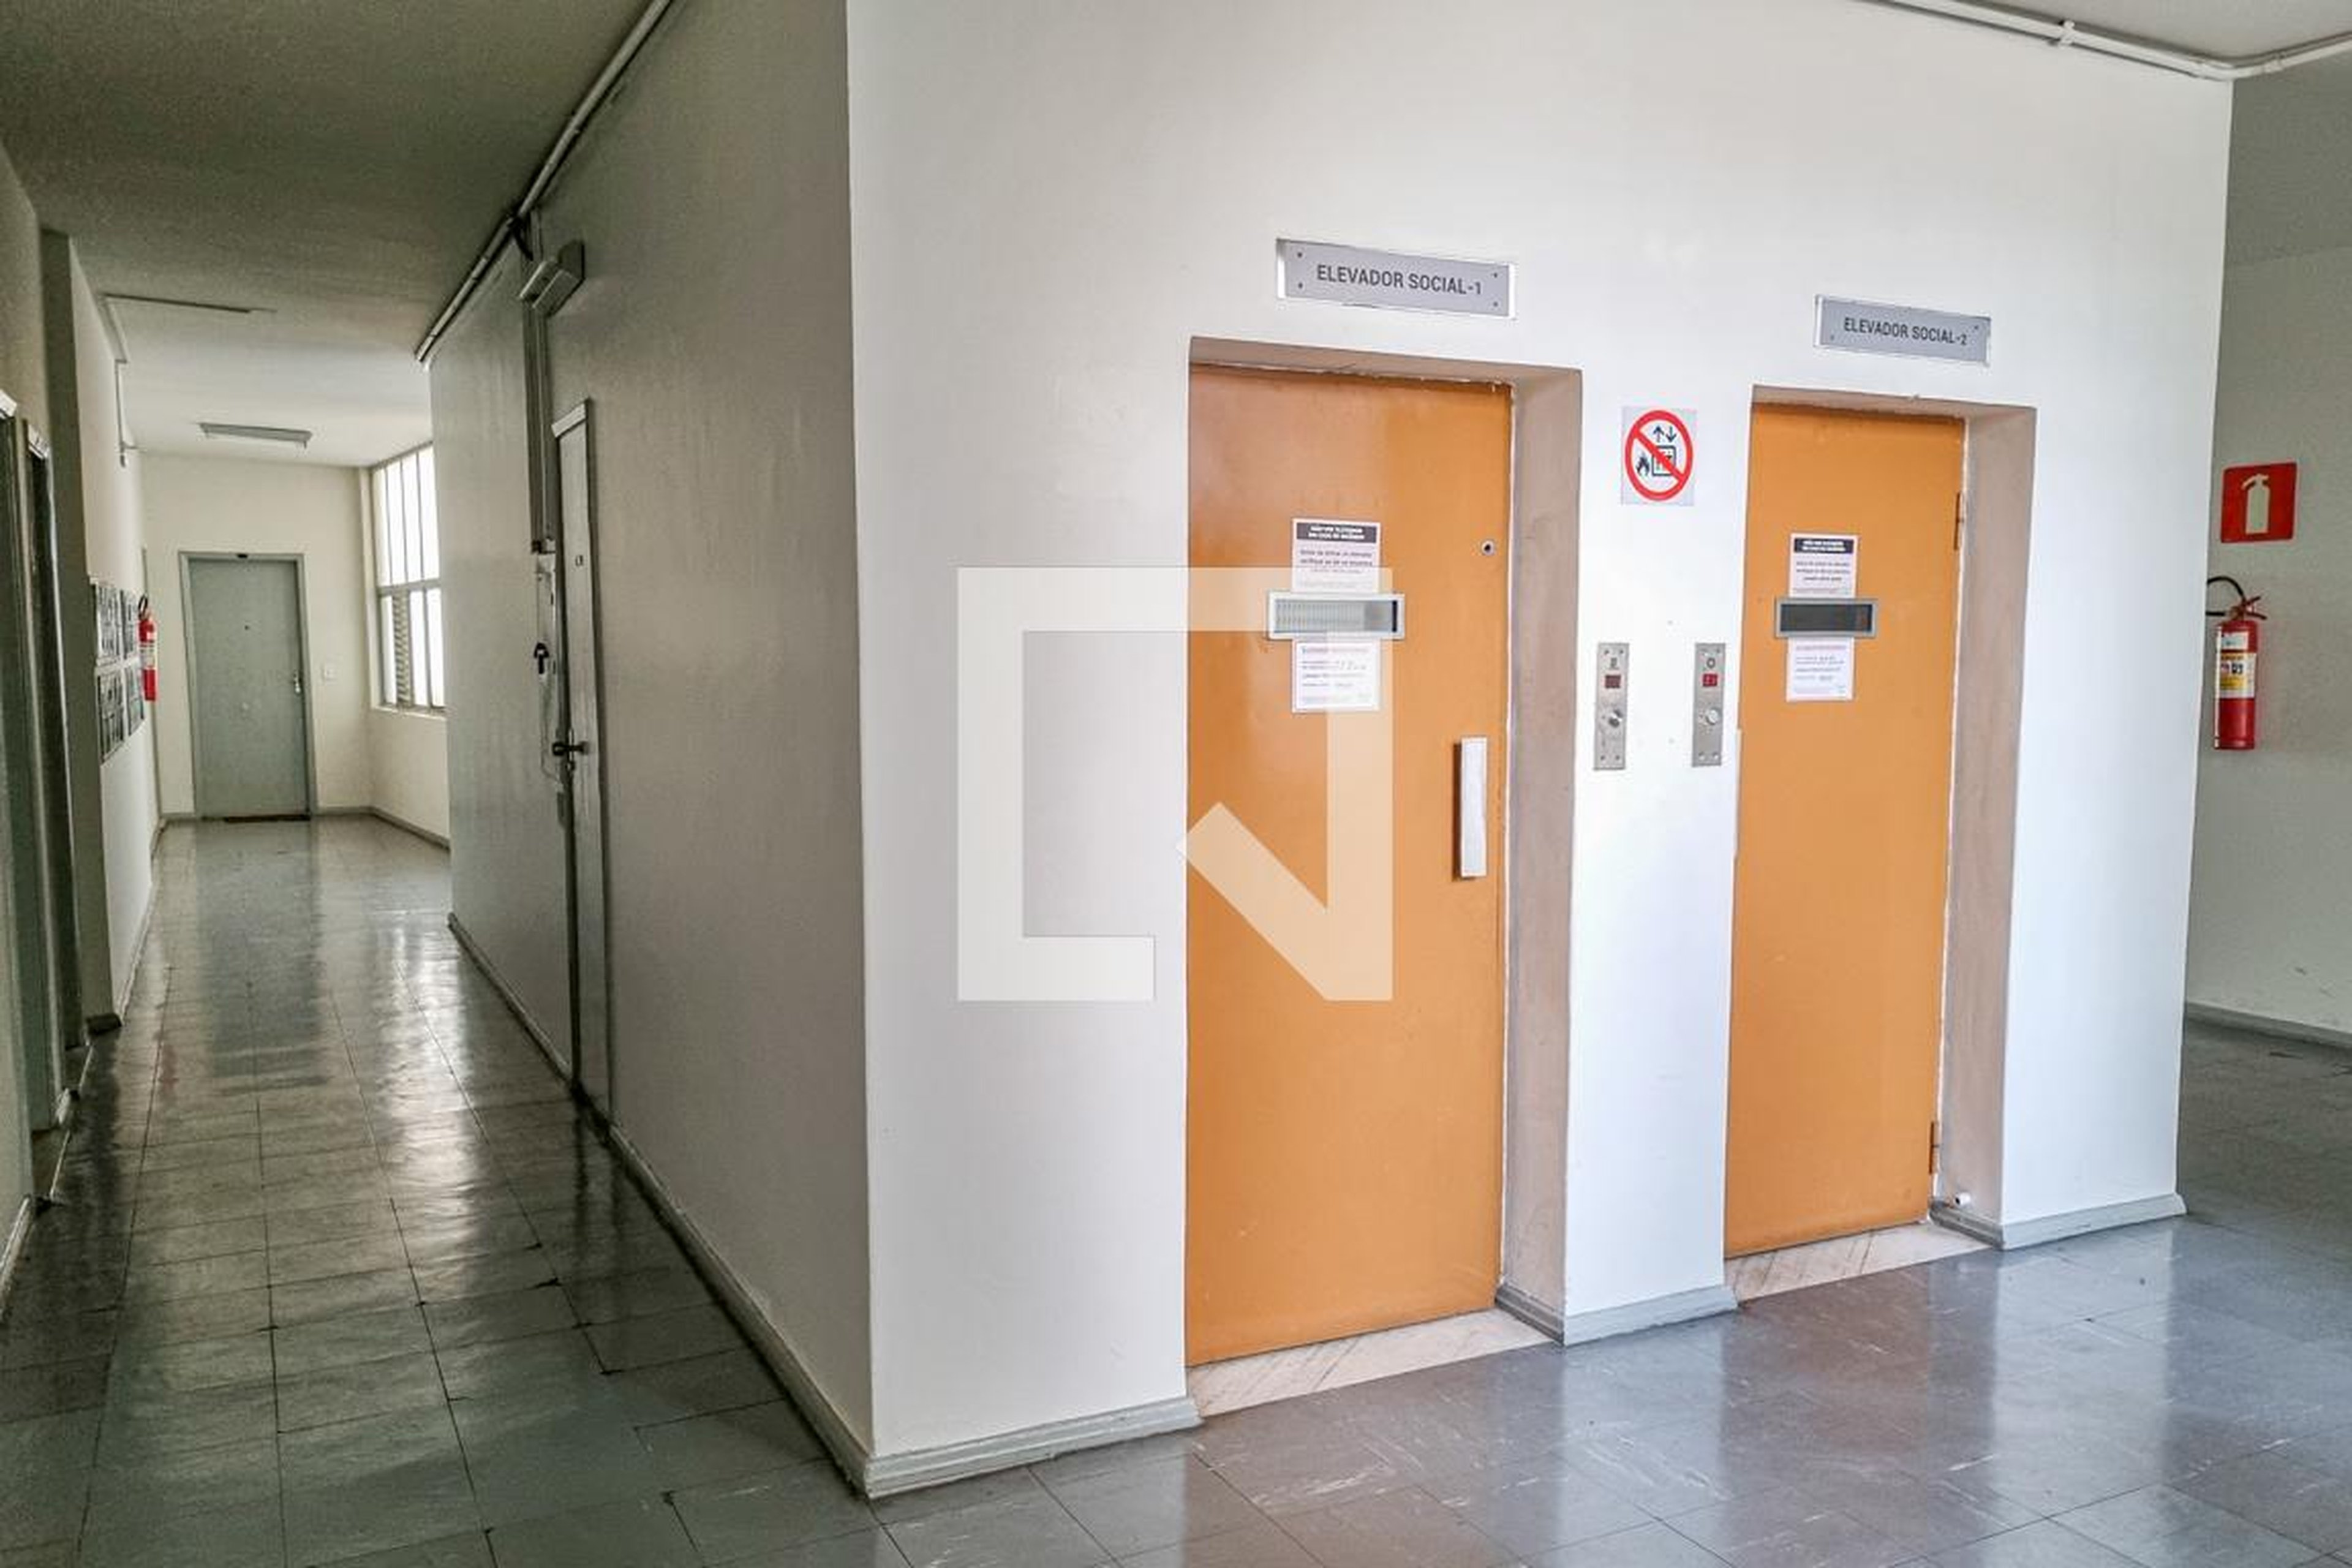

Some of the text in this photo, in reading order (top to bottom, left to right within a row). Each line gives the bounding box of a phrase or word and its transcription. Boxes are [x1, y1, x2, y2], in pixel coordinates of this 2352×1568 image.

[1316, 264, 1482, 295] ELEVADOR SOCIAL-1
[1844, 317, 1967, 345] ELEVADOR SOCIAL-2
